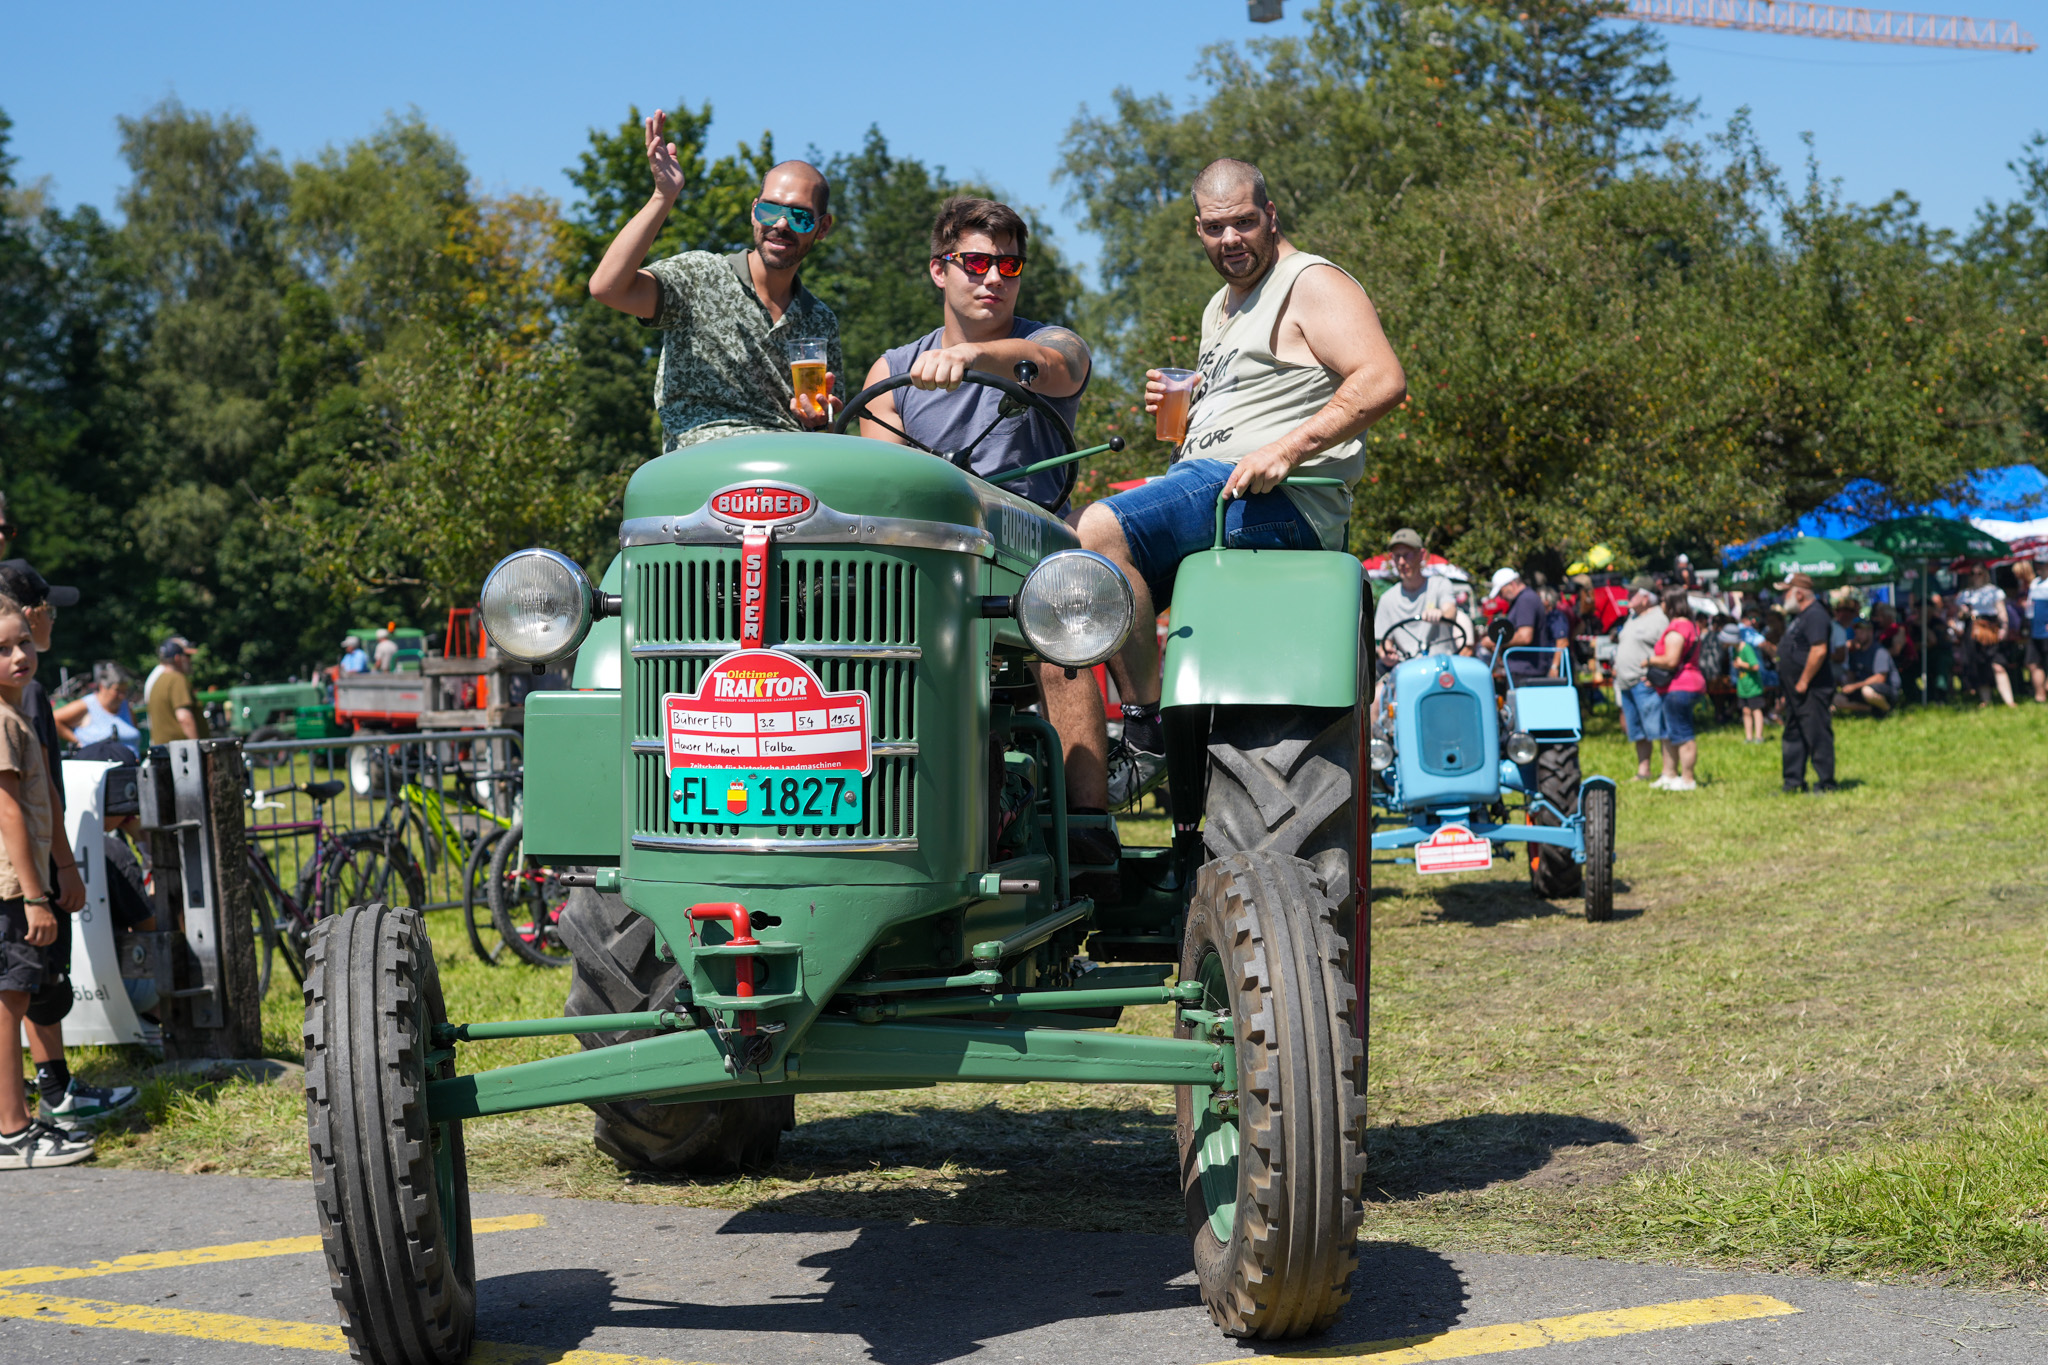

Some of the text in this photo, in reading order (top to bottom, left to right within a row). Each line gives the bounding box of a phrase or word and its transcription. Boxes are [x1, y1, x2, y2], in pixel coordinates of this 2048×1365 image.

[743, 554, 762, 640] SUPER
[726, 670, 779, 679] Oldtimer
[713, 671, 808, 698] TRAKTOR
[759, 718, 775, 728] 3.2
[798, 716, 814, 728] 54
[831, 714, 855, 725] 1956
[682, 776, 846, 816] FL 1827
